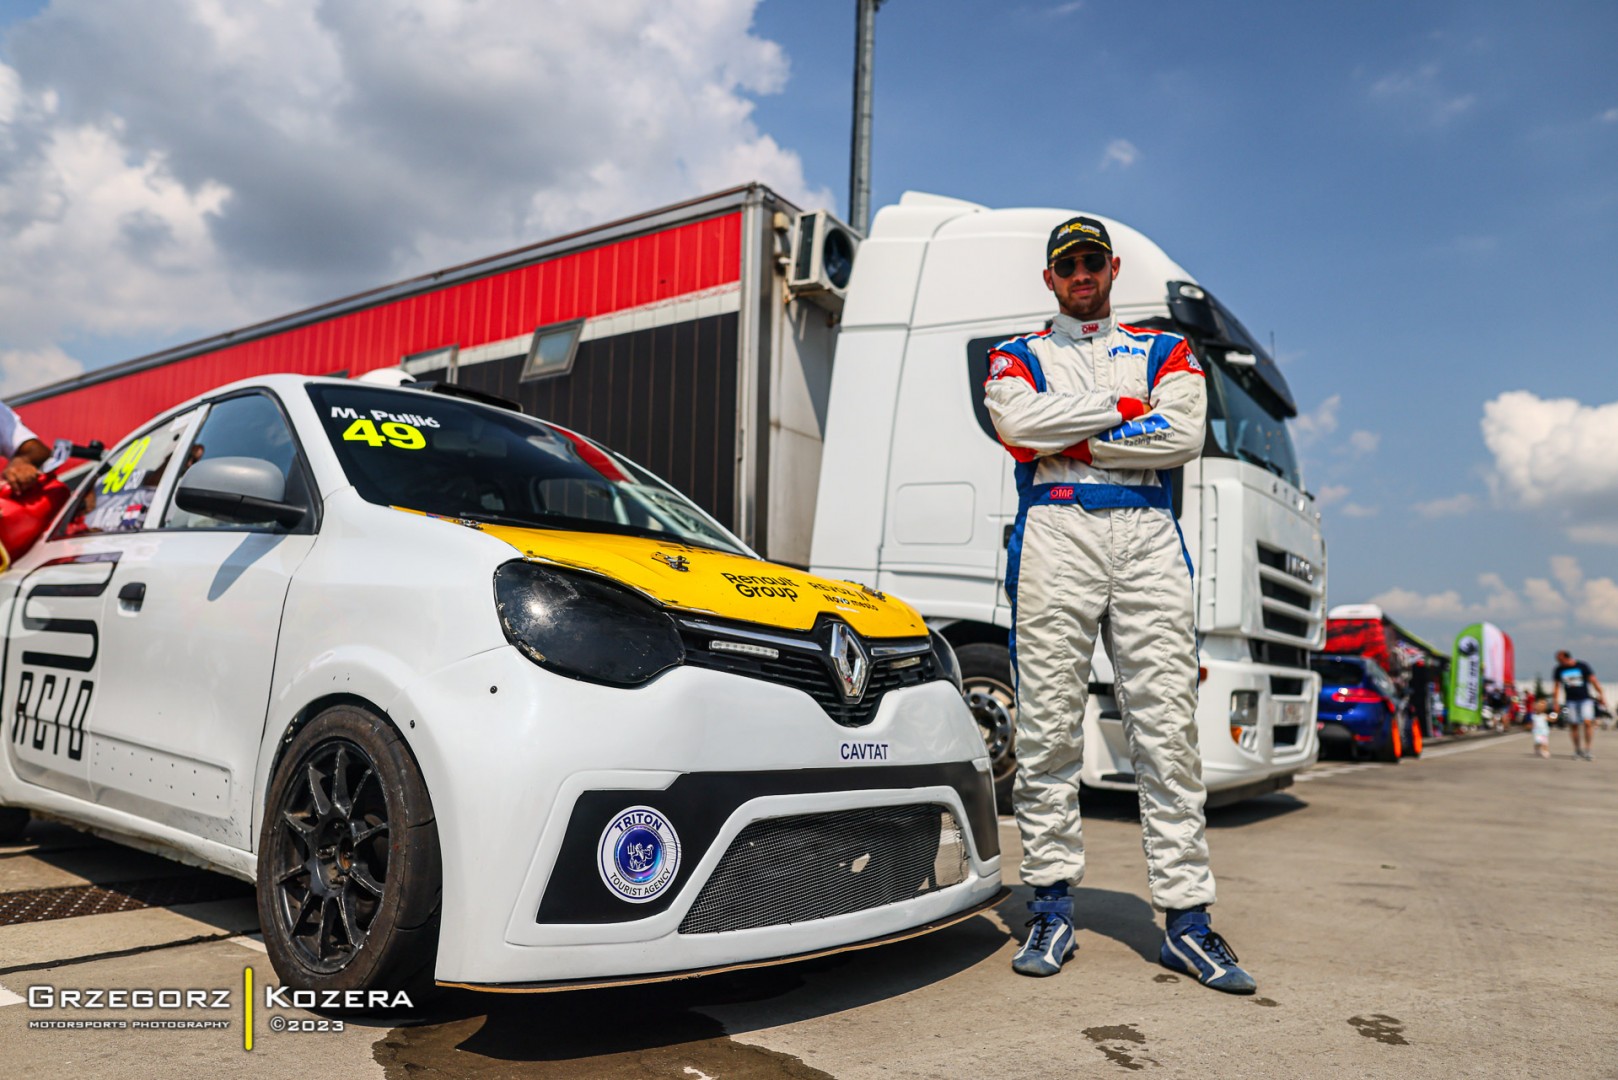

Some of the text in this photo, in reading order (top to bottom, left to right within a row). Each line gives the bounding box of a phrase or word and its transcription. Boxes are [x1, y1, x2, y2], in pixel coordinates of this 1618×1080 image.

[331, 406, 366, 419] M.
[342, 419, 427, 450] 49
[102, 435, 151, 495] 49
[1050, 487, 1074, 499] OMP
[720, 572, 800, 588] Renault
[735, 583, 798, 603] Group
[840, 743, 889, 760] CAVTAT
[615, 812, 662, 832] TRITON
[610, 867, 671, 896] TOURIST AGENCY
